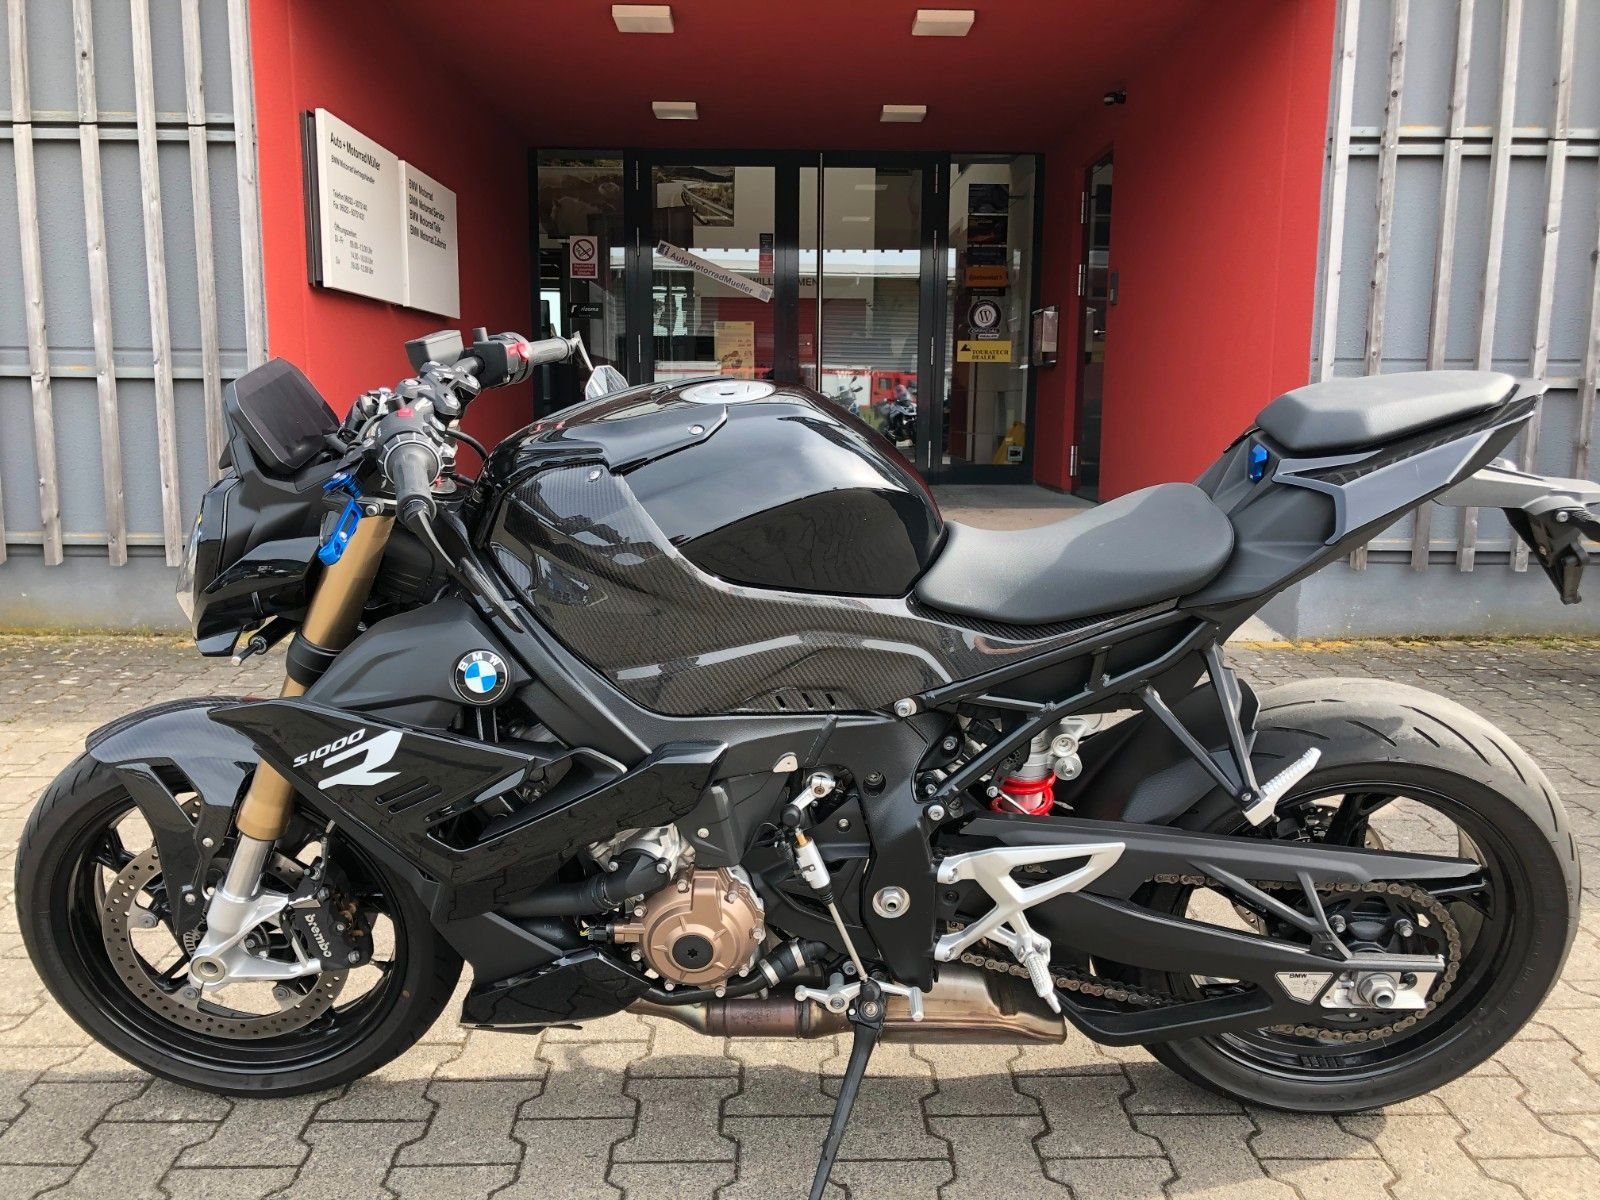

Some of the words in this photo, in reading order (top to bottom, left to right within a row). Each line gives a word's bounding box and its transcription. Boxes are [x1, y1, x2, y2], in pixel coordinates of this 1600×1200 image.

[330, 132, 342, 149] Auto
[408, 178, 418, 192] BMW
[419, 184, 433, 201] Motorrad
[409, 194, 418, 208] BMW
[409, 209, 419, 222] BMW
[410, 224, 419, 237] BMW
[670, 252, 753, 294] AutoMotorradMueller
[457, 652, 501, 672] BMW
[292, 728, 366, 768] S1000
[304, 913, 332, 958] brembo
